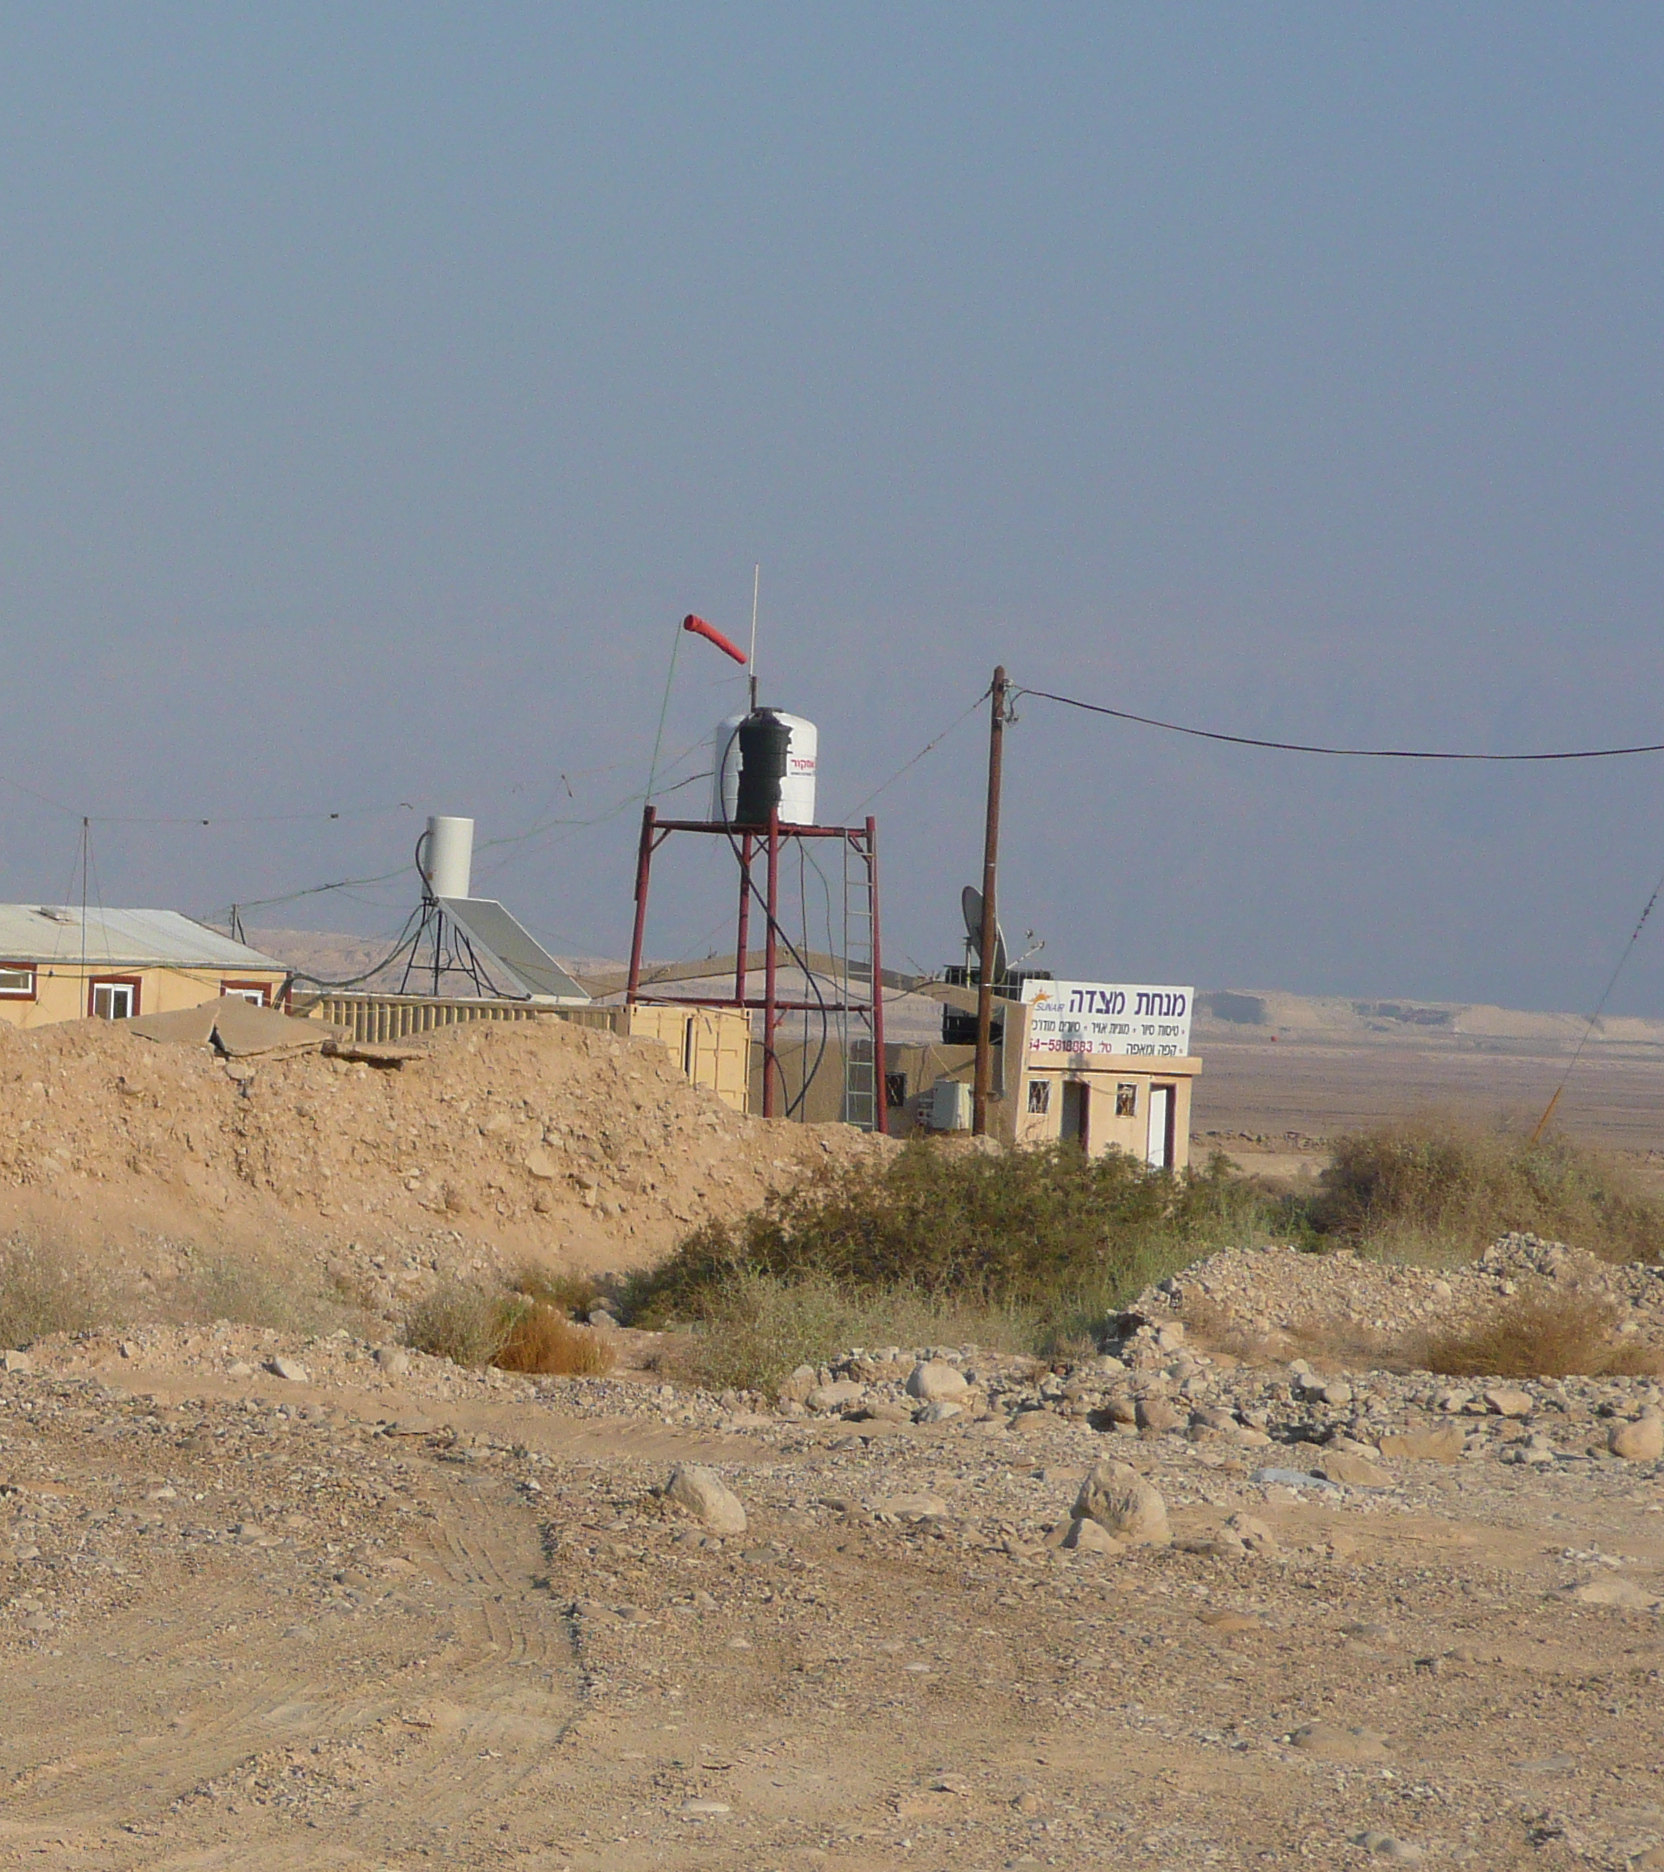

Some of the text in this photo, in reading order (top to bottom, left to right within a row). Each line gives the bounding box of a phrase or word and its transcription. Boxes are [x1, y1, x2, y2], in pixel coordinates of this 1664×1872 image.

[1070, 990, 1186, 1016] מנחת מצדה
[1157, 1043, 1178, 1057] קפה
